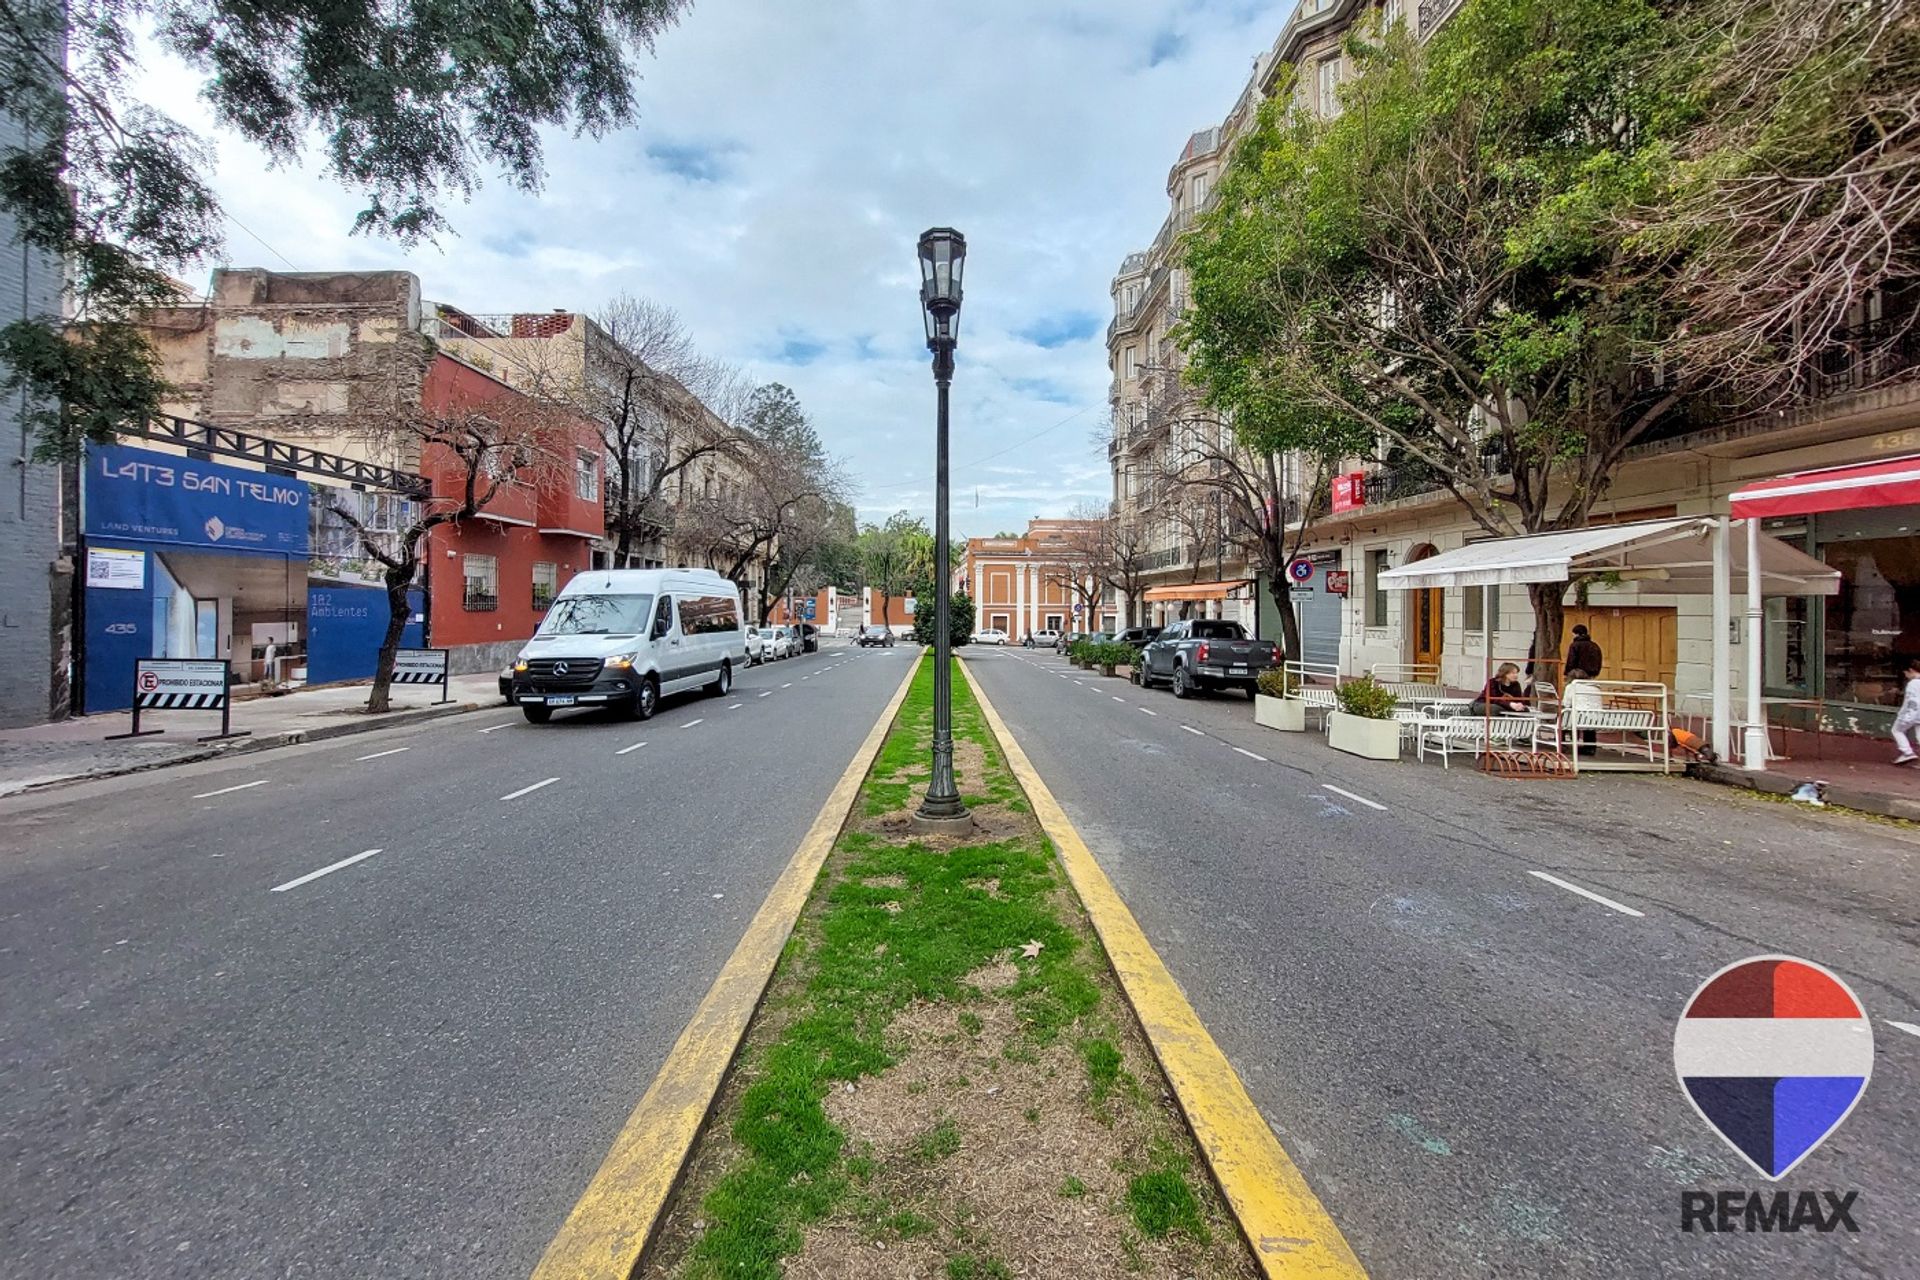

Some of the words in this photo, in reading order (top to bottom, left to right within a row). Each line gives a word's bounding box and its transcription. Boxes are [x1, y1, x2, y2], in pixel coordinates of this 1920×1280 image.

[1872, 432, 1914, 449] 438
[102, 457, 174, 487] L4T3
[182, 471, 231, 496] SAN
[101, 522, 129, 531] LAND
[131, 525, 179, 535] VENTURES
[311, 606, 368, 617] Ambientes
[105, 623, 137, 634] 435
[189, 679, 224, 687] ESTACIONAR
